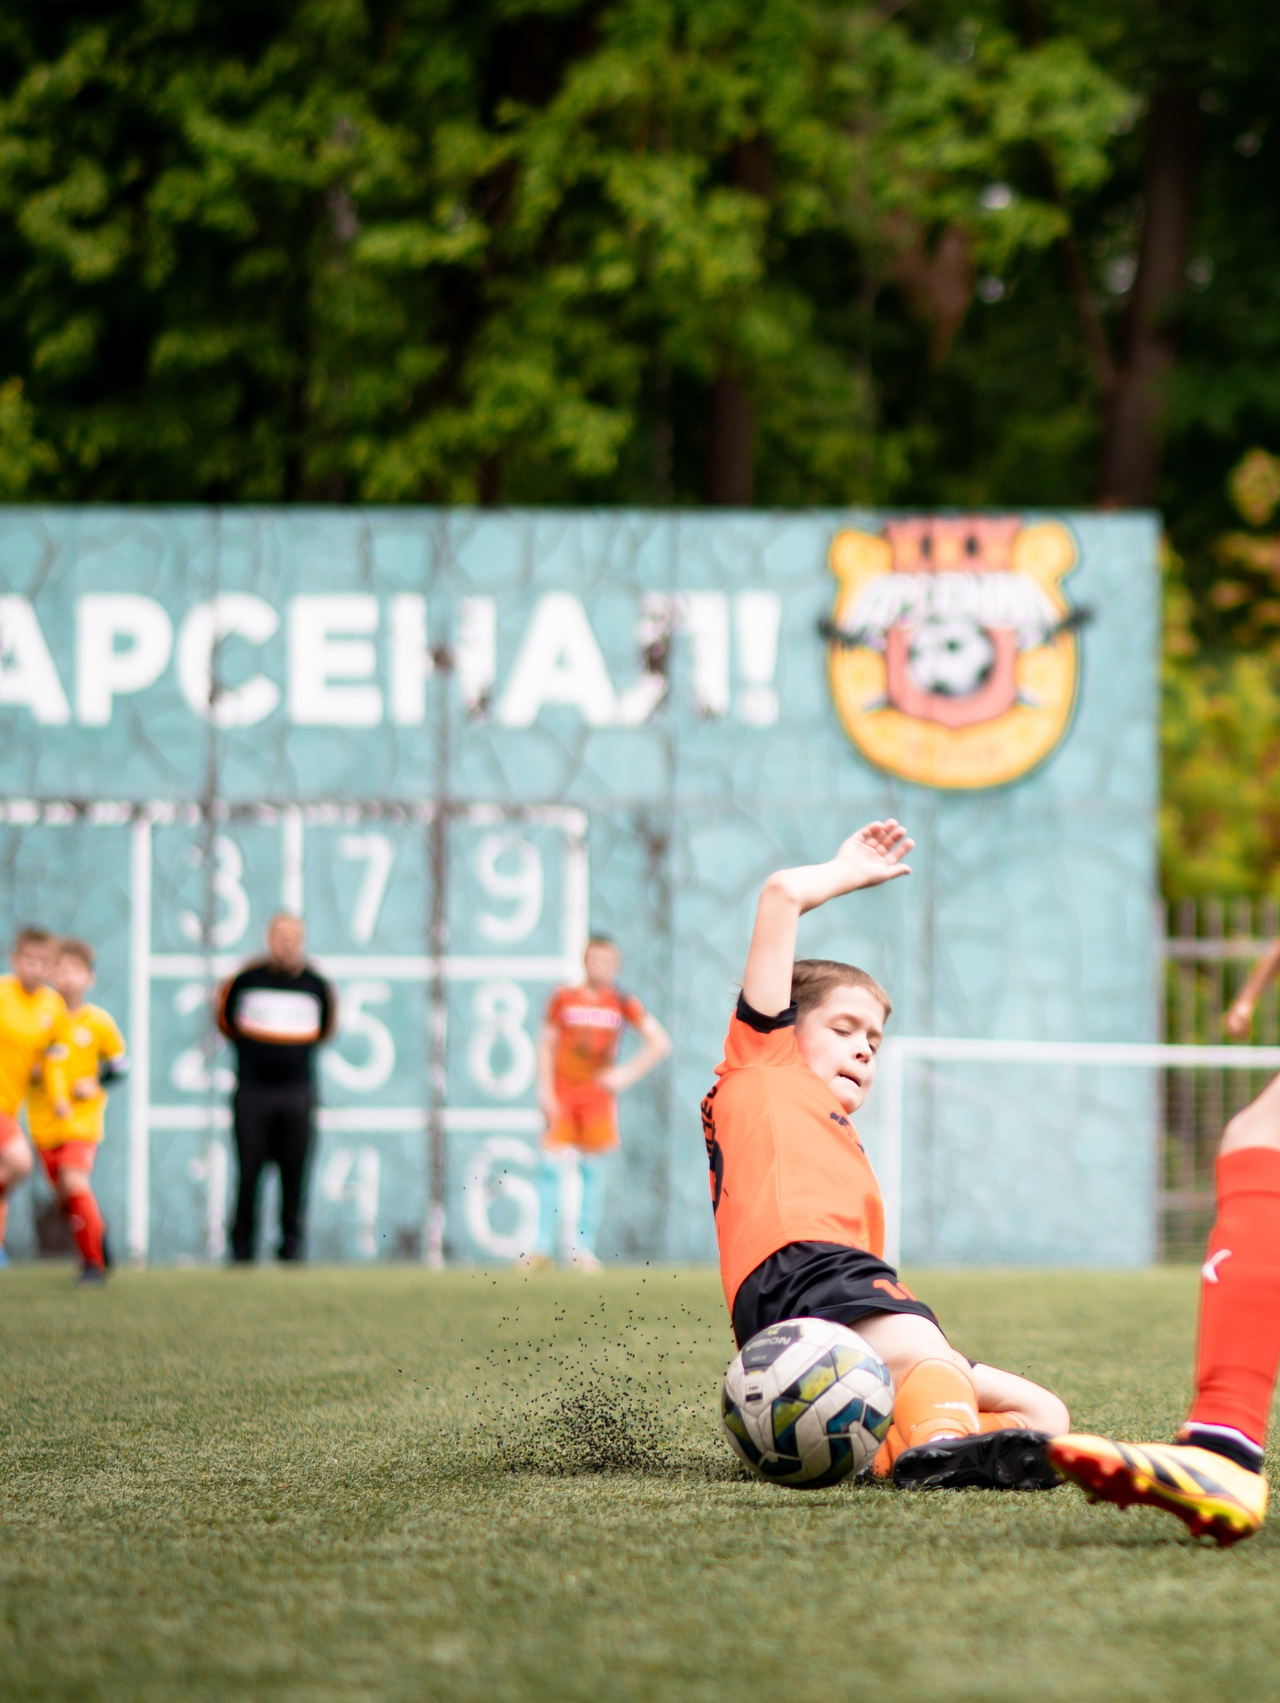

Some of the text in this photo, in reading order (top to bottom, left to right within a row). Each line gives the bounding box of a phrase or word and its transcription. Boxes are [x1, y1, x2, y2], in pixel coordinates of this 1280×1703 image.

[0, 591, 782, 728] АРСЕНАЛ!
[180, 833, 544, 947] 3 7 9
[323, 980, 396, 1094] 5
[469, 981, 535, 1099] 8
[322, 1146, 380, 1257] 4
[466, 1137, 542, 1256] 6
